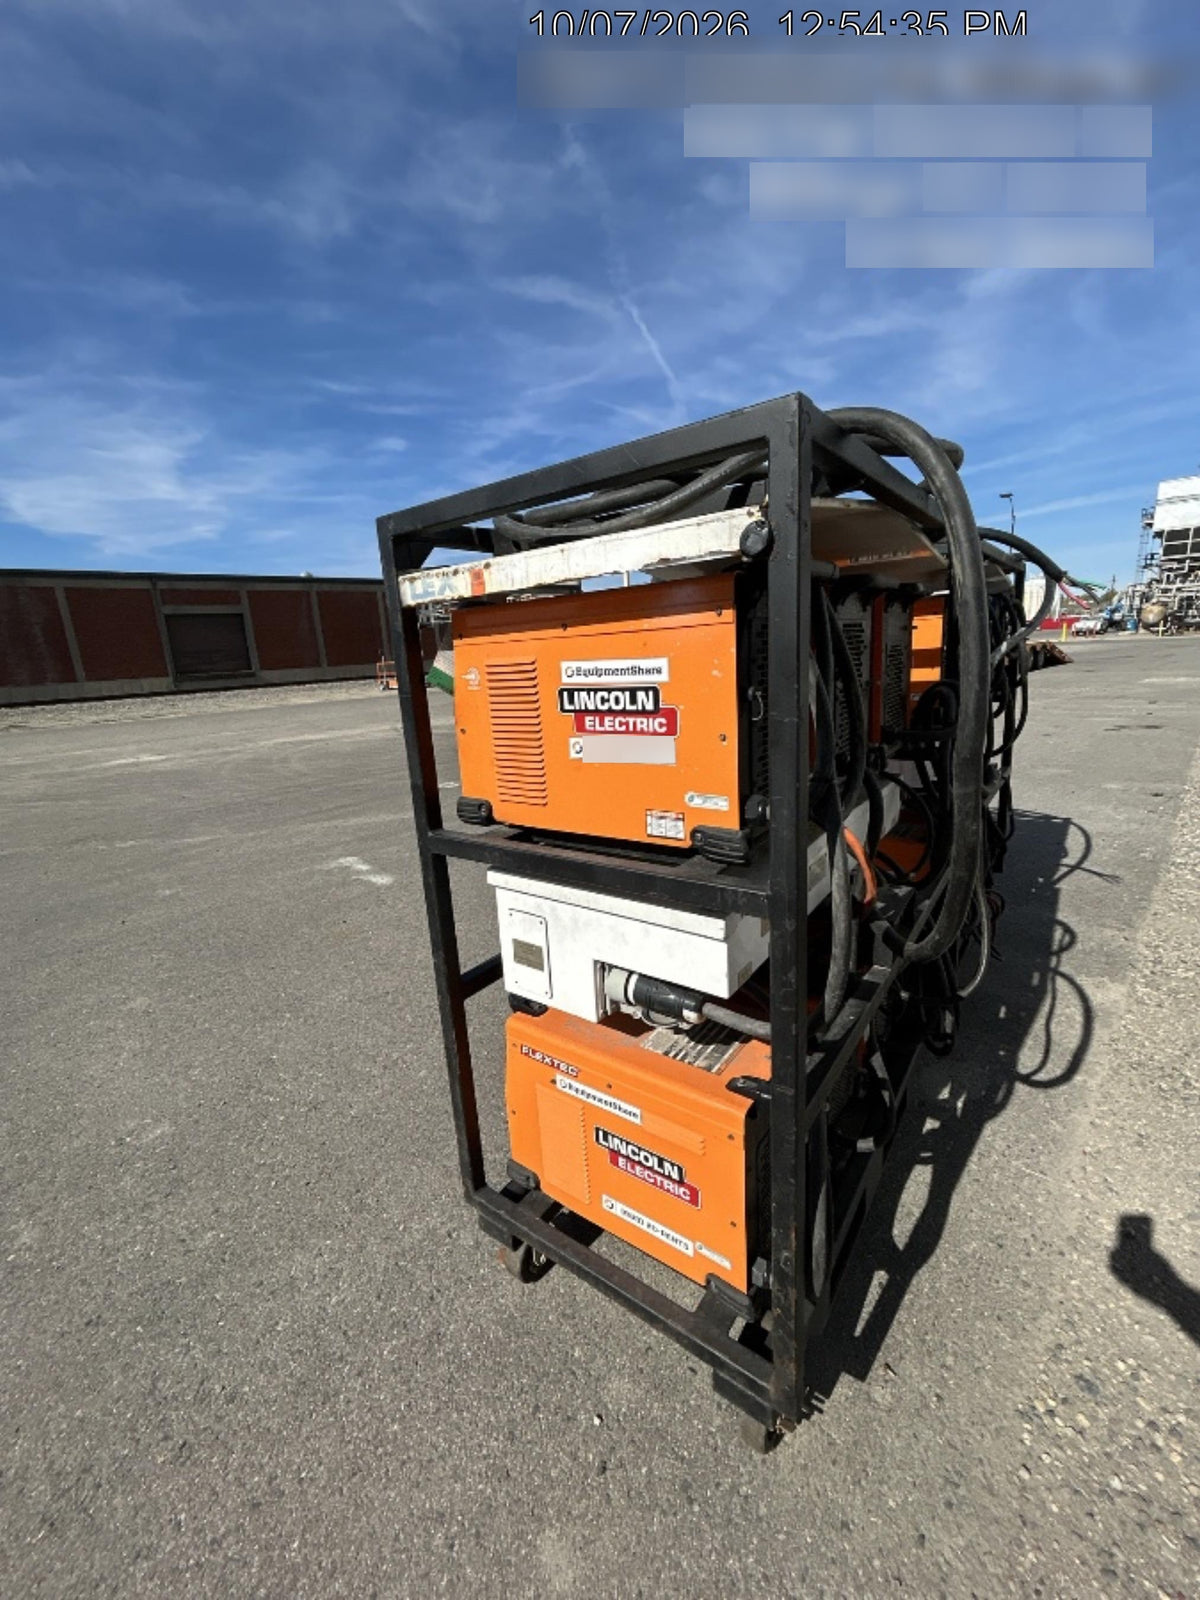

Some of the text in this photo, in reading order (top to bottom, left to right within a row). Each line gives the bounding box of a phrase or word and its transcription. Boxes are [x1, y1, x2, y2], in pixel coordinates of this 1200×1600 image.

[575, 665, 663, 678] EquipmentShare
[563, 690, 655, 711] LINCOLN
[584, 716, 668, 733] ELECTRIC
[521, 1044, 579, 1077] FLEXTEC
[598, 1130, 680, 1181] LINCOLN
[618, 1157, 691, 1201] ELECTRIC
